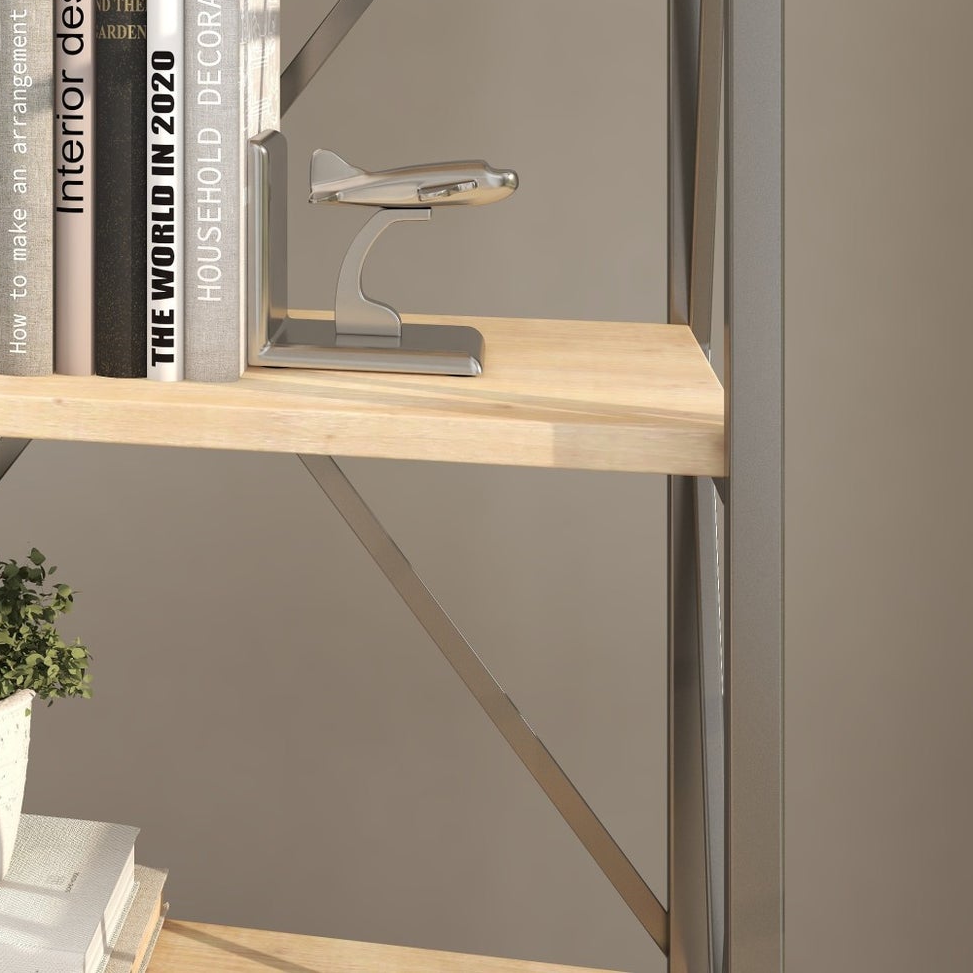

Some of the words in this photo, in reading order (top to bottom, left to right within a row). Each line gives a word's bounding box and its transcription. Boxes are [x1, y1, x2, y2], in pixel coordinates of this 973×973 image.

[96, 24, 147, 40] ARDEN
[10, 9, 33, 155] arrangement
[151, 50, 175, 135] 2020
[56, 69, 84, 214] Interior
[151, 144, 175, 176] IN
[13, 169, 28, 194] an
[8, 208, 28, 262] make
[151, 185, 175, 301] WORLD
[197, 128, 222, 302] HOUSEHOLD
[9, 275, 28, 300] to
[9, 313, 28, 355] How
[151, 309, 175, 367] THE
